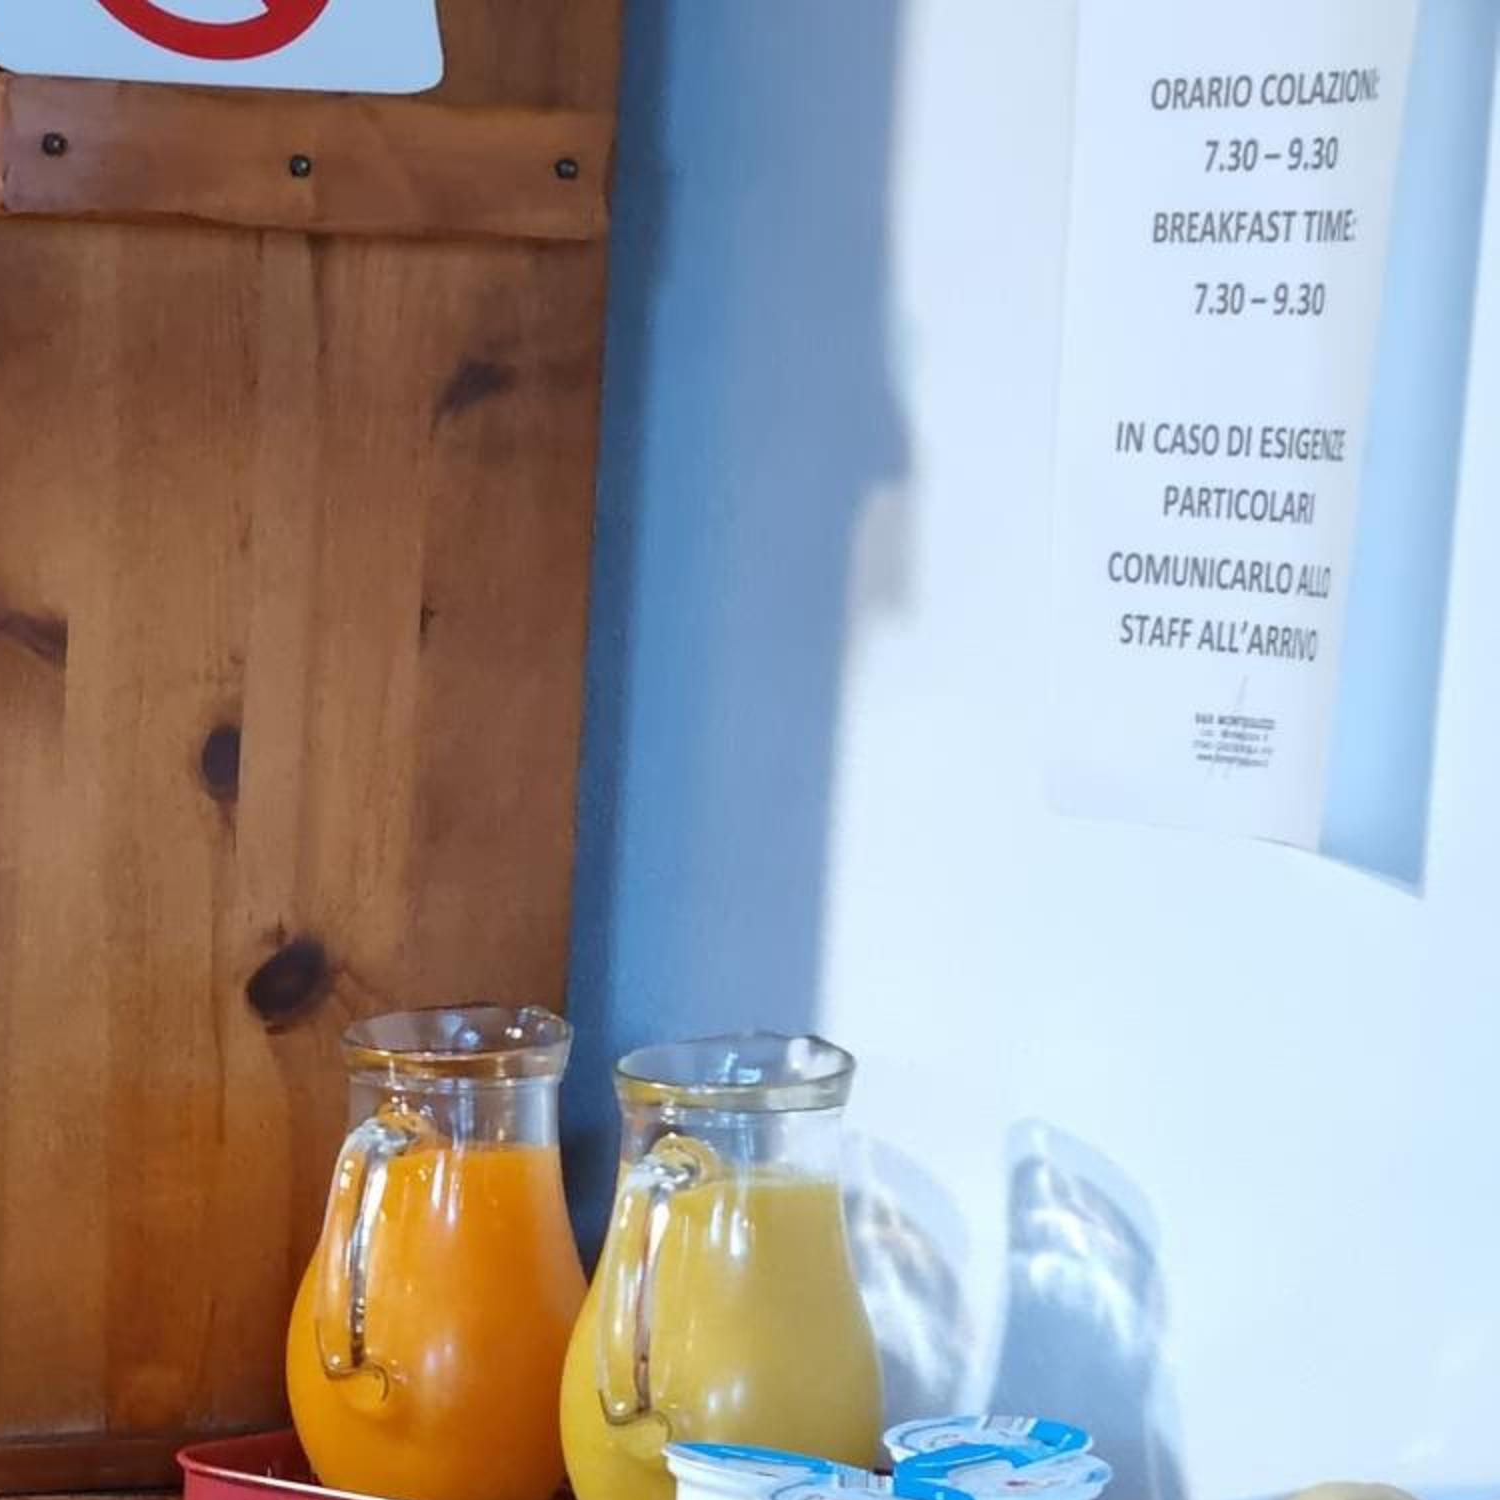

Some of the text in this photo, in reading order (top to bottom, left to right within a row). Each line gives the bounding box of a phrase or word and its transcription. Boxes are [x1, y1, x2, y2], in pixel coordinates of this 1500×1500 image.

[1151, 75, 1253, 111] ORARIO
[1205, 138, 1259, 172] 7.30
[1287, 136, 1339, 171] 9.30
[1152, 211, 1298, 244] BREAKFAST
[1194, 282, 1246, 315] 7.30
[1273, 282, 1326, 316] 9.30
[1115, 421, 1347, 462] IN CASO DI ESIGENZE
[1163, 485, 1316, 524] PARTICOLARI
[1108, 551, 1332, 600] COMUNICARLO ALLO
[1120, 613, 1194, 649] STAFF
